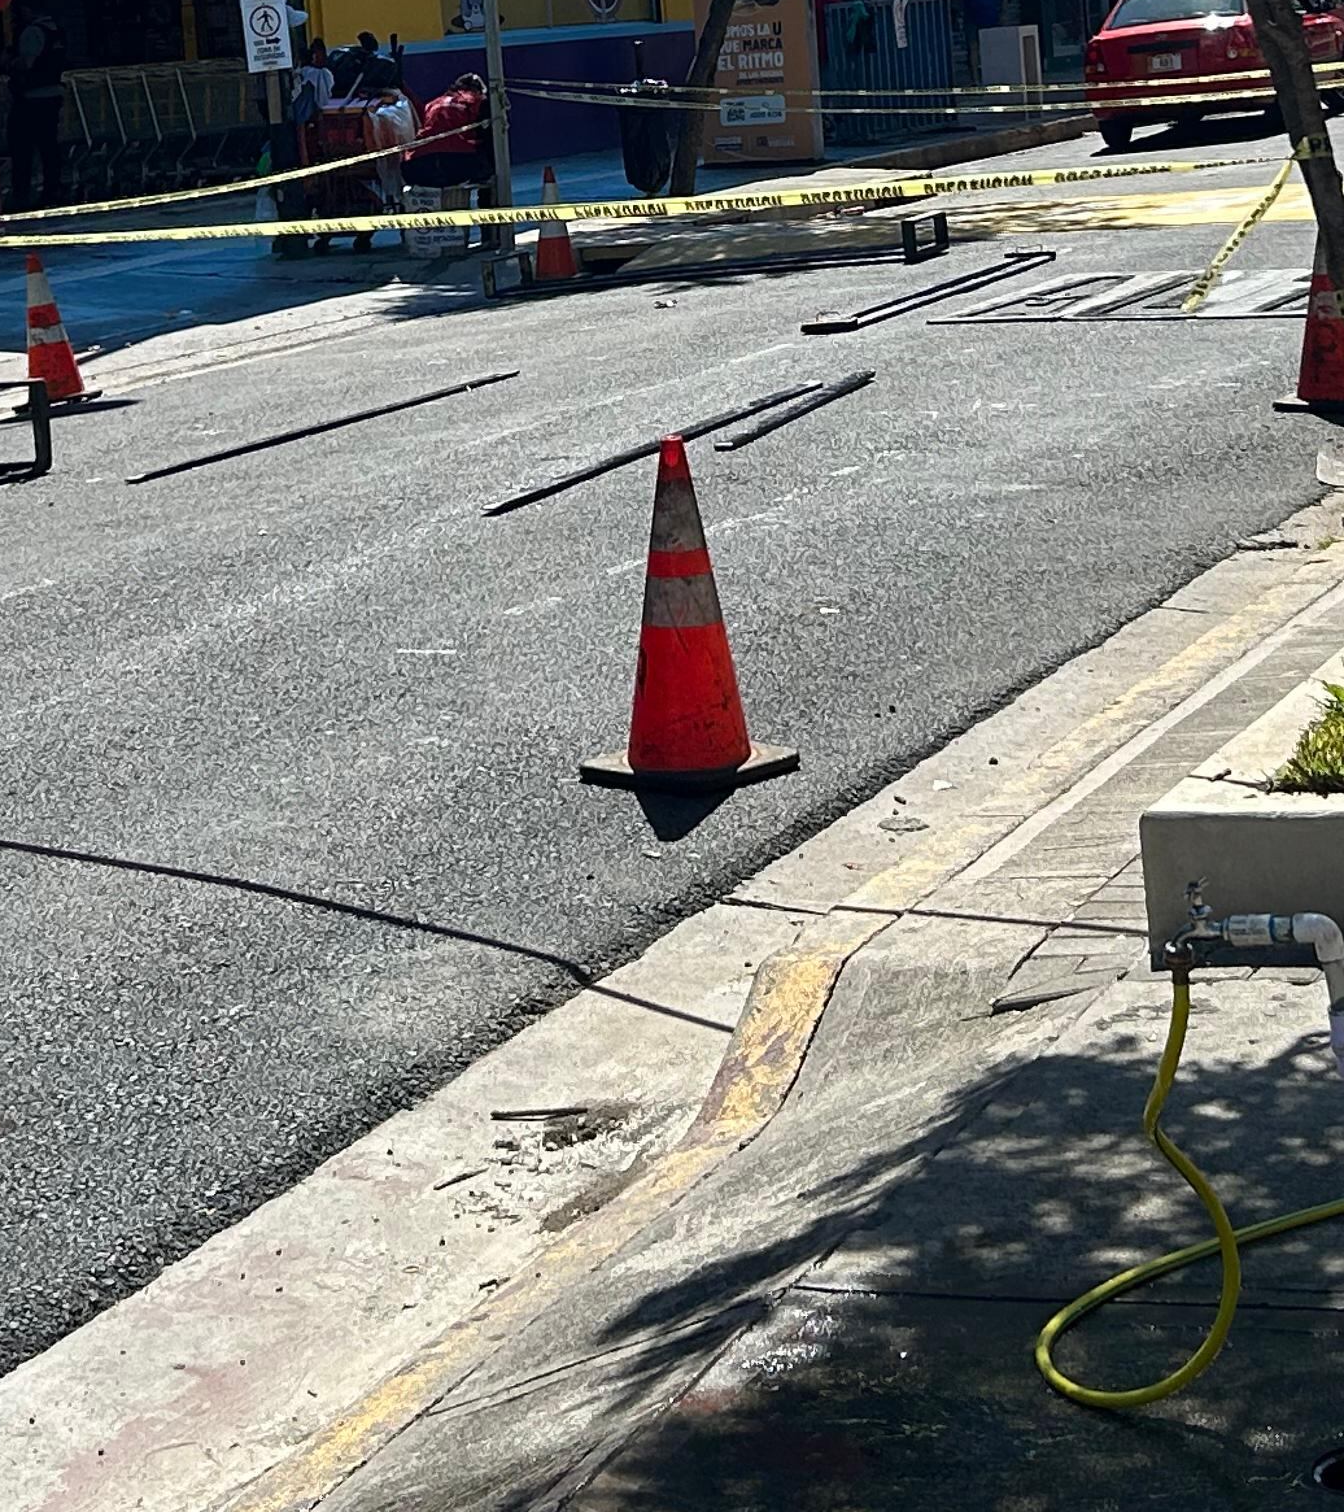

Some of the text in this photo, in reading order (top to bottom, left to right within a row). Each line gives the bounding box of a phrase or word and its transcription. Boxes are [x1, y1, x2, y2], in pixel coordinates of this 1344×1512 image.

[757, 22, 770, 36] LA
[773, 21, 782, 36] U
[720, 37, 784, 54] UE MARCA
[716, 51, 785, 71] EL RITMO
